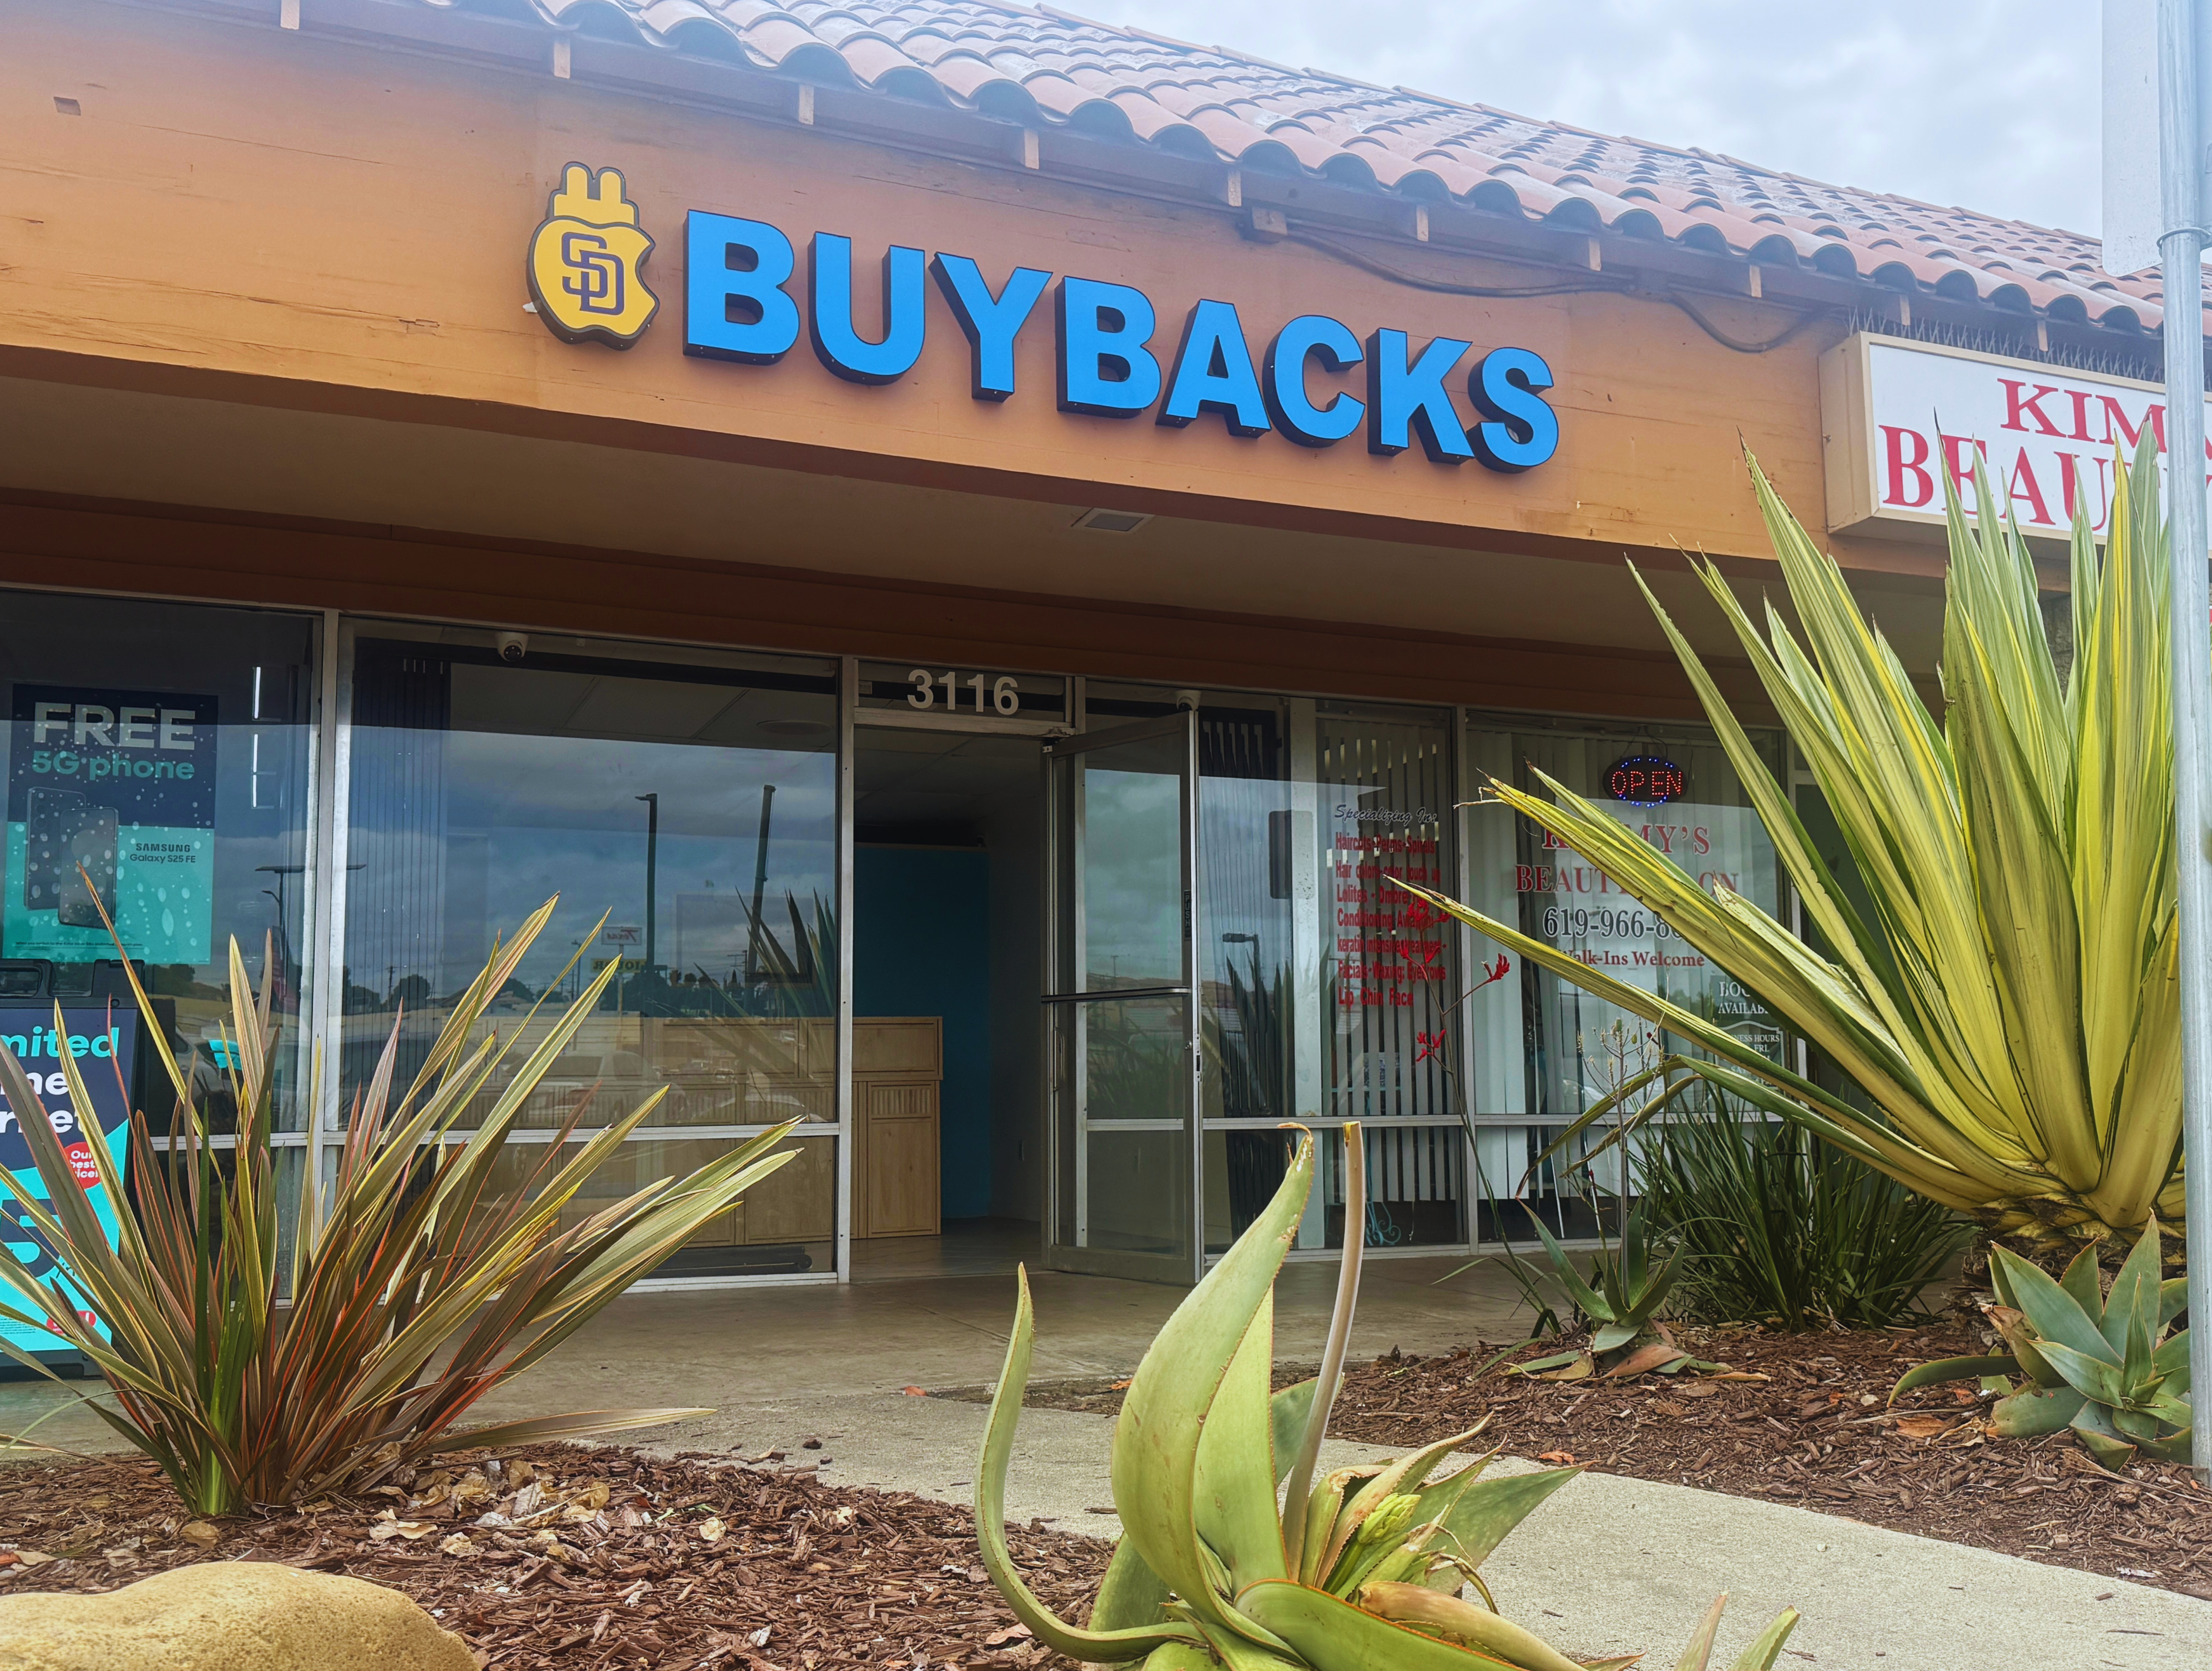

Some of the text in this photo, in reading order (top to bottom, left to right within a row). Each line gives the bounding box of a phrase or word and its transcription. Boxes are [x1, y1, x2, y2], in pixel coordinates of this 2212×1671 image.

[684, 209, 1559, 474] BUYBACKS
[1997, 378, 2212, 460] KIM
[907, 669, 1019, 715] 3116
[34, 702, 196, 750] FREE
[32, 751, 195, 780] 5G phone
[1611, 770, 1682, 796] OPEN
[1334, 804, 1413, 826] Specializing
[129, 854, 166, 864] Galaxy
[136, 843, 190, 852] SAMSUNG
[1336, 860, 1352, 878] Hair
[1515, 865, 1630, 894] BEAUT
[1337, 907, 1393, 933] Conditioning
[1337, 933, 1364, 952] keratin
[1631, 950, 1704, 966] Welcome
[1338, 986, 1414, 1008] Lip Chin Face
